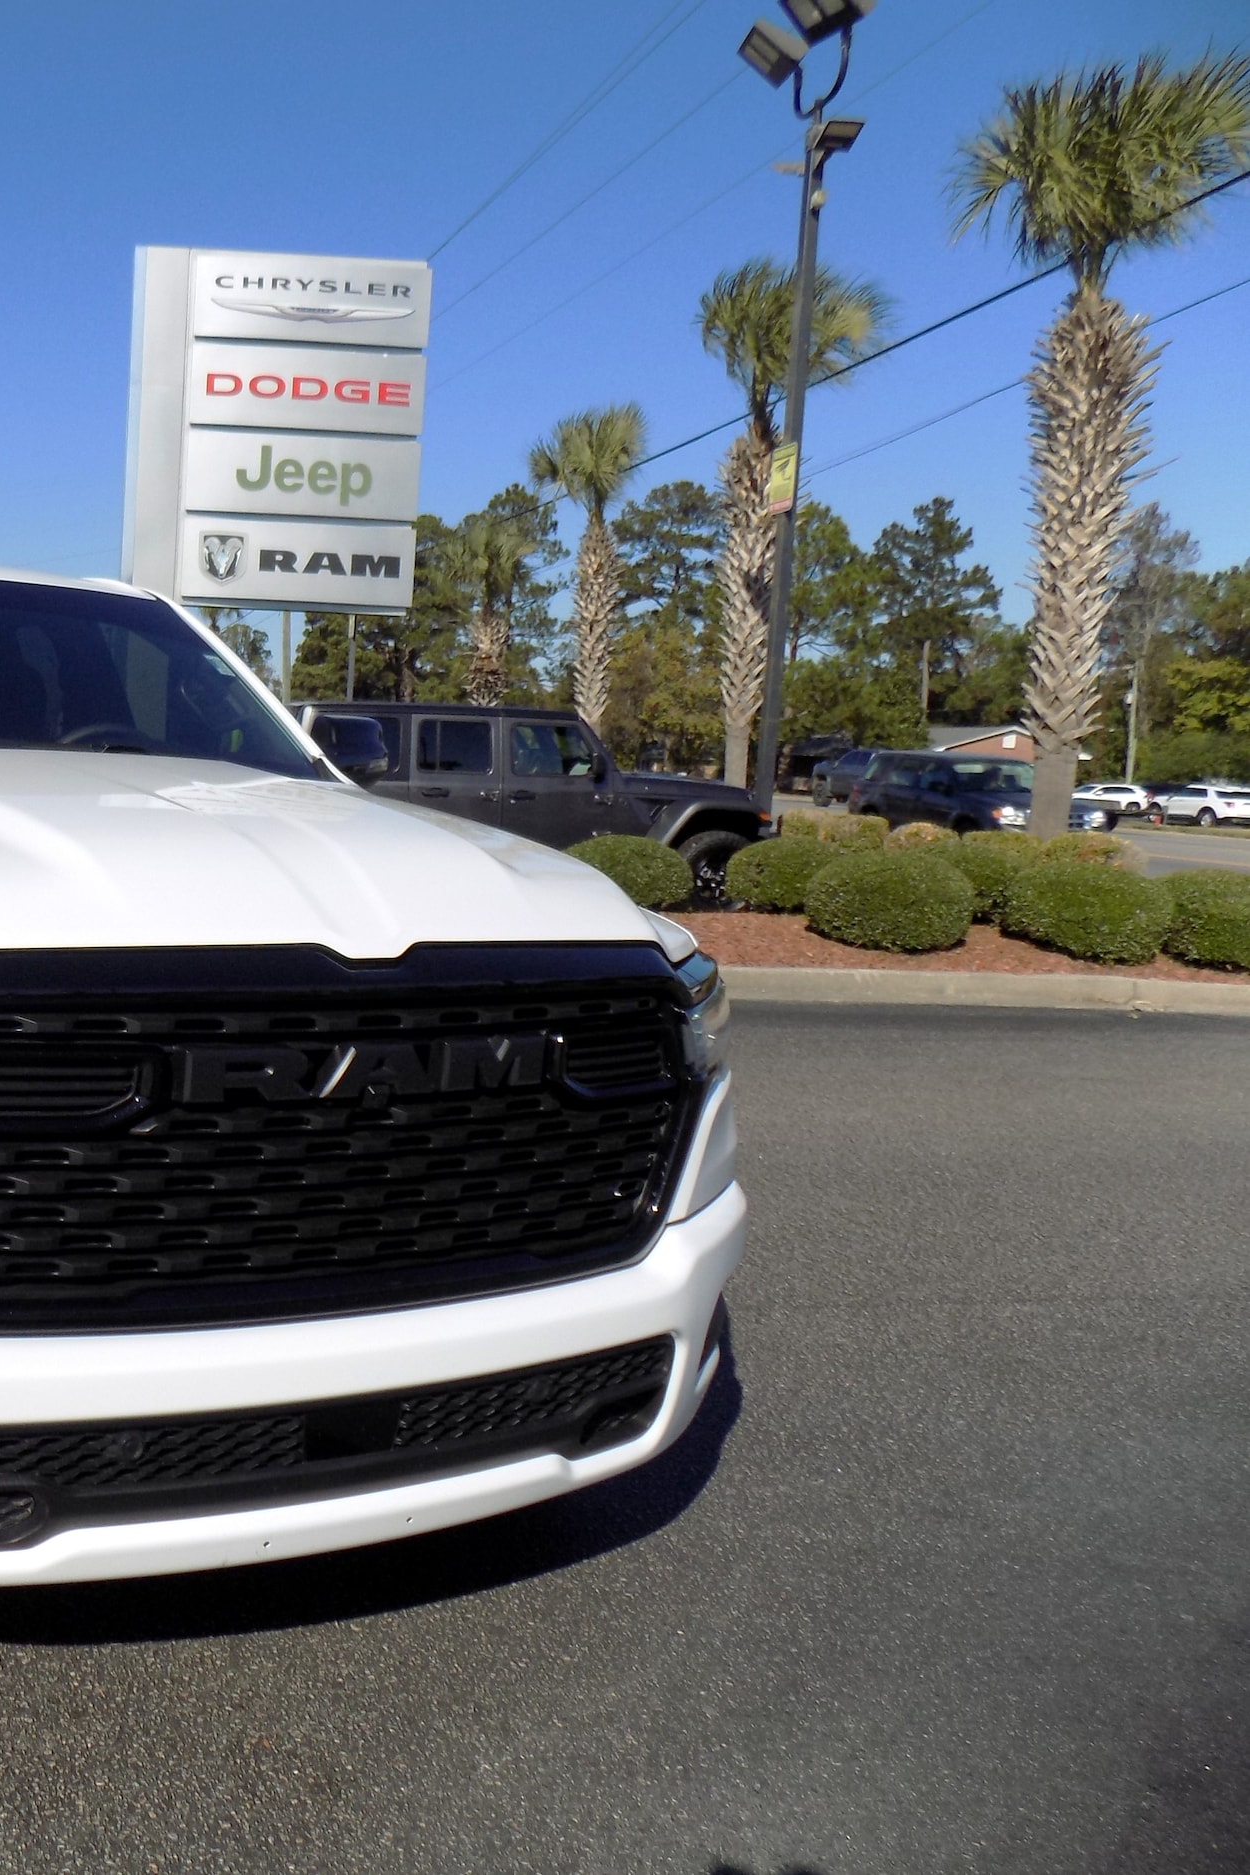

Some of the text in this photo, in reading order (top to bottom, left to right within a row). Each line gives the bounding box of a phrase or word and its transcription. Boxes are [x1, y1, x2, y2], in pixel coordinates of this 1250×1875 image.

[215, 275, 412, 298] CHRYSLER
[205, 372, 411, 406] DODGE
[236, 445, 372, 506] Jeep
[258, 549, 400, 578] RAM
[171, 1033, 547, 1102] RAM
